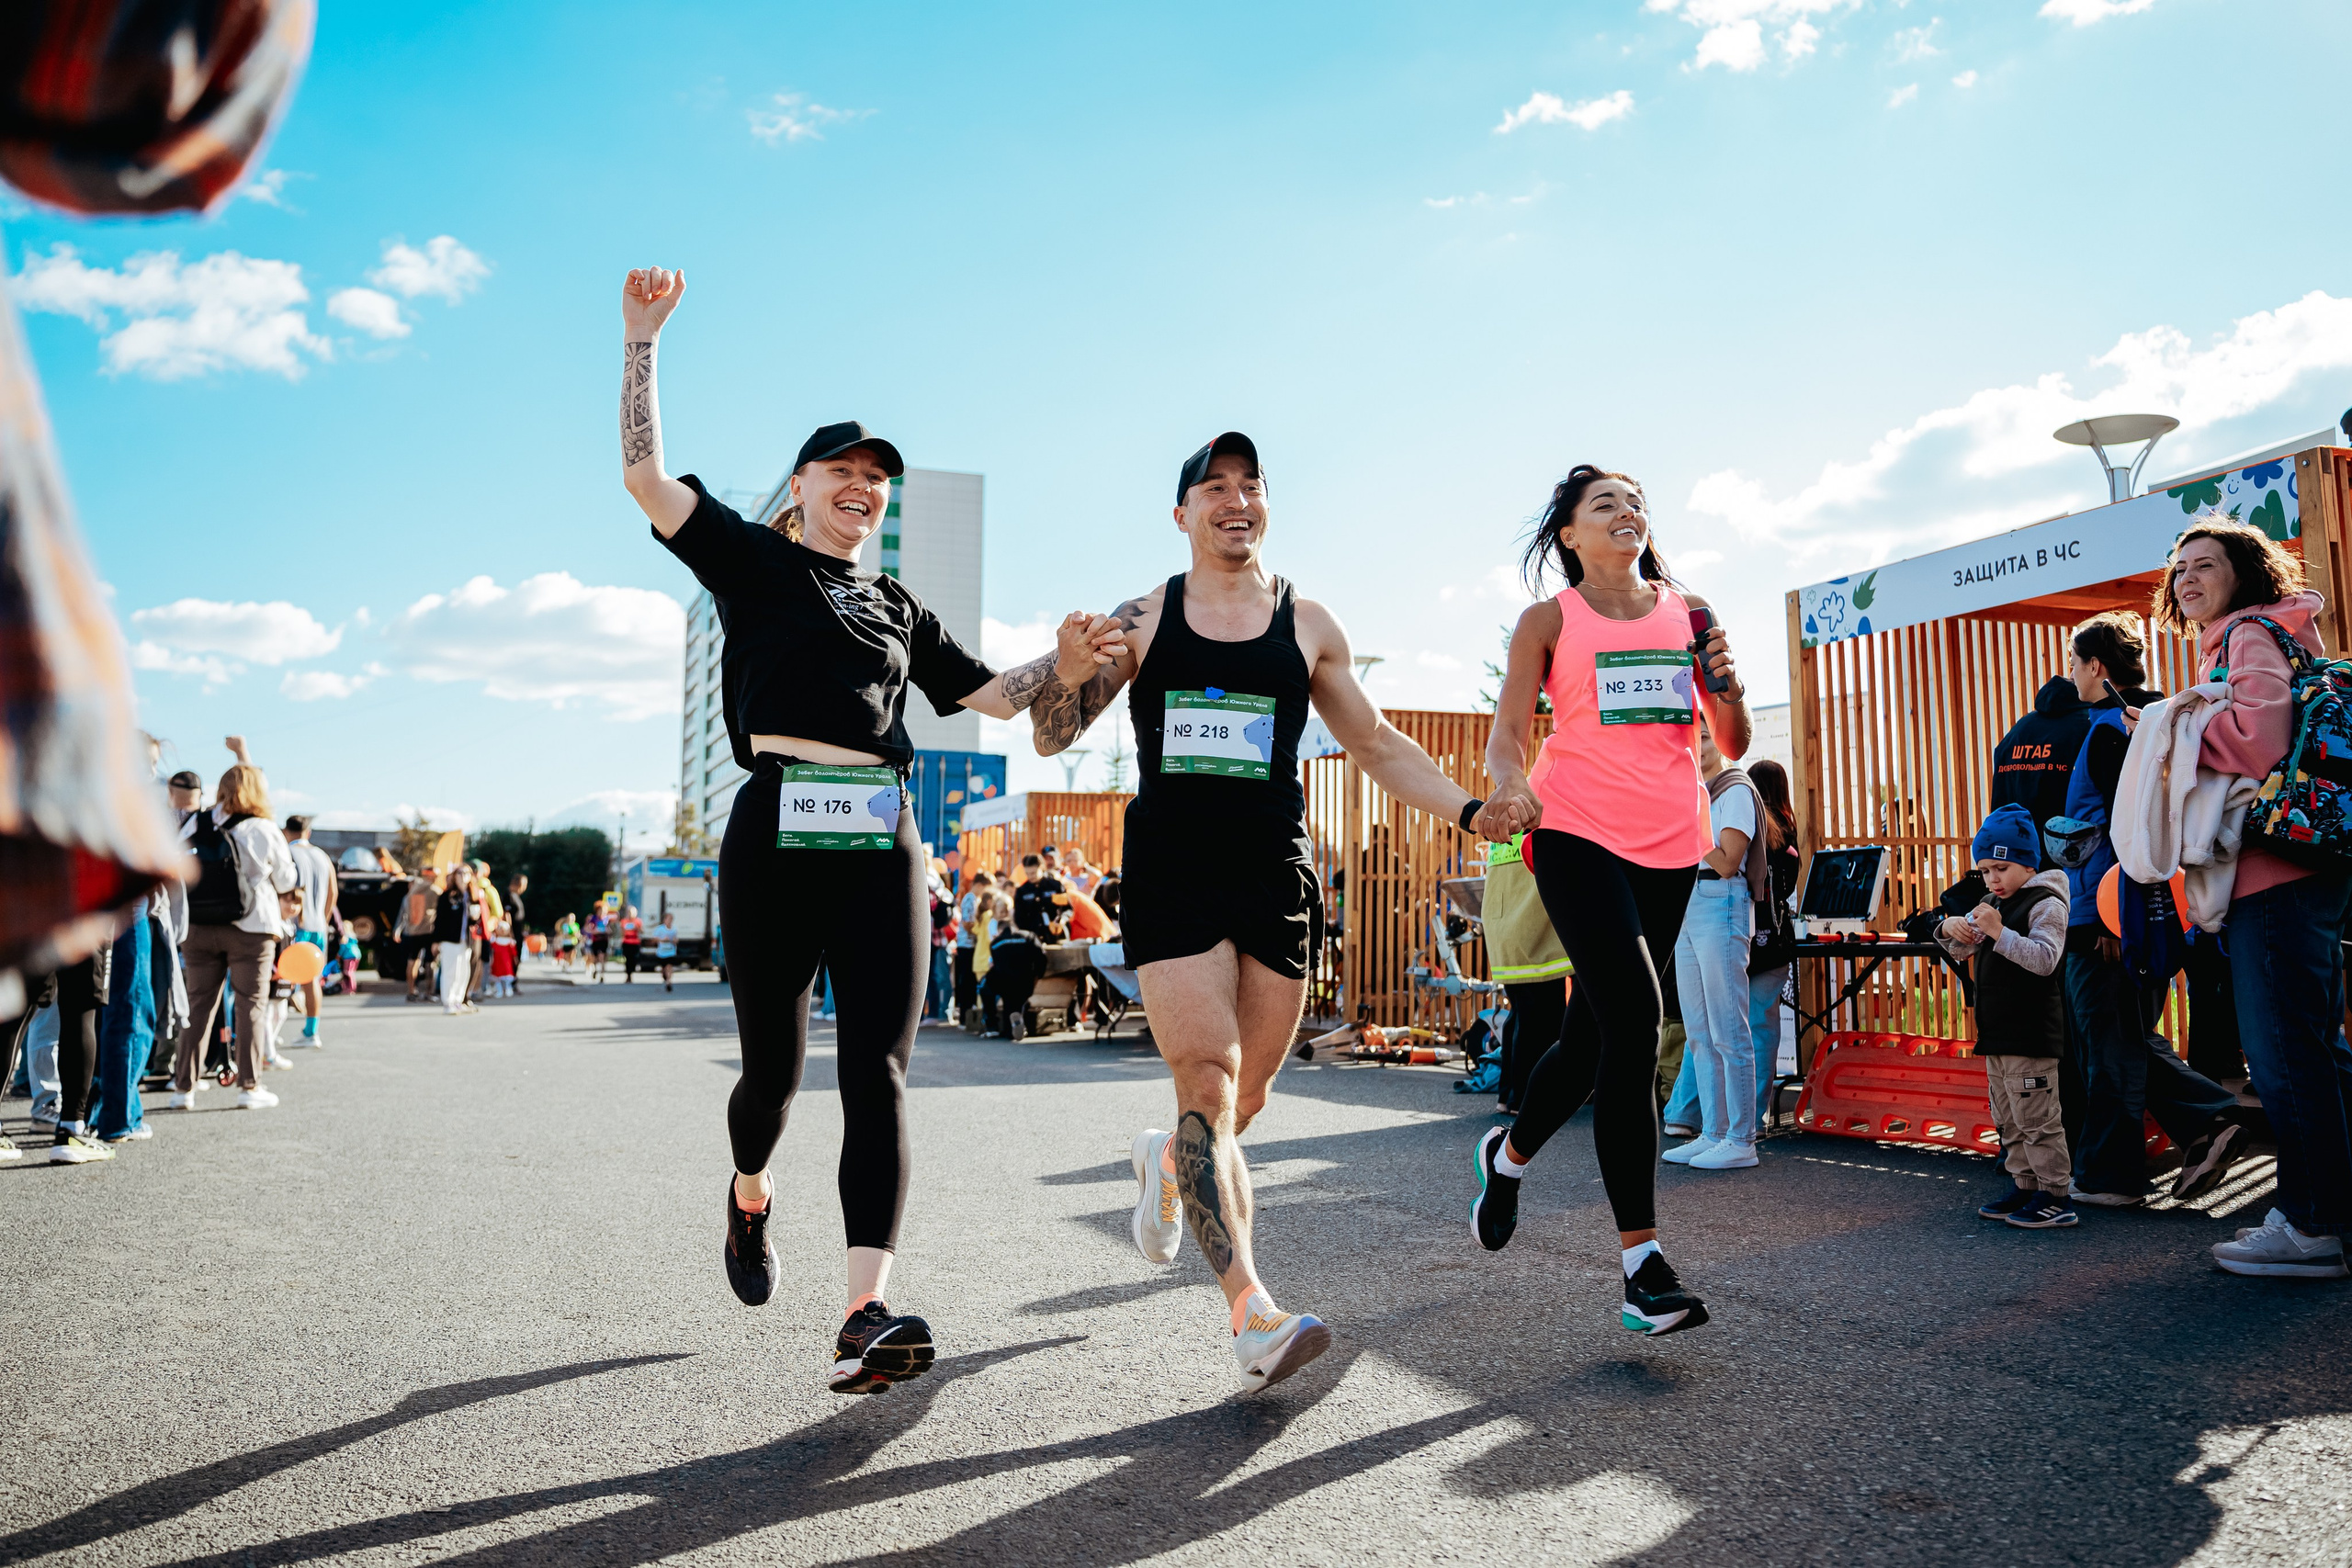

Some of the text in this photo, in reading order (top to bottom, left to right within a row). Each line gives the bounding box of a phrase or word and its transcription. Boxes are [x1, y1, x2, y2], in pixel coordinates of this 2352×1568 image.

[1953, 540, 2081, 587] ЗАЩИТА В ЧС
[1633, 679, 1663, 693] 233
[1199, 725, 1229, 739] 218
[2011, 743, 2052, 760] ШТАБ
[1998, 762, 2068, 773] ДОБРОВОЛЬЦЕВ В ЧС
[823, 800, 852, 815] 176
